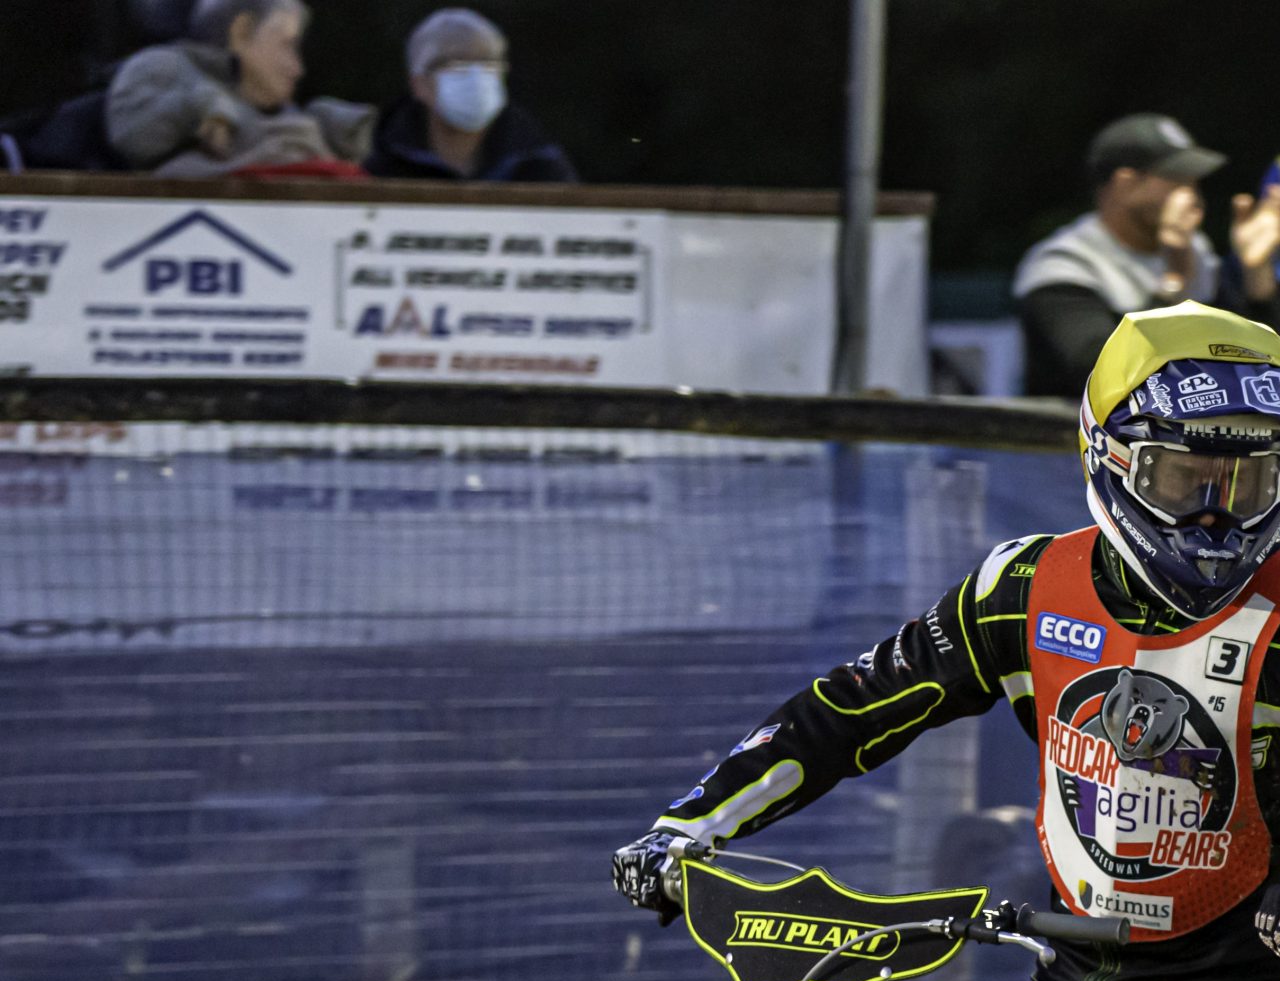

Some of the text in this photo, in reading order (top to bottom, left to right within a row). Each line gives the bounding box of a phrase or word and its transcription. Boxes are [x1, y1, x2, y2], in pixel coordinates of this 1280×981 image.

[145, 258, 243, 295] PBI
[1180, 376, 1216, 391] PPG
[1121, 517, 1157, 558] seaspan
[1040, 617, 1101, 650] ECCO
[1212, 642, 1240, 675] 3
[1049, 719, 1121, 787] REDCAR
[1097, 785, 1202, 832] agilia
[1090, 842, 1141, 876] SPEEDWAY
[1152, 829, 1229, 867] BEARS
[1095, 892, 1171, 919] erimus
[737, 916, 785, 941] TRU
